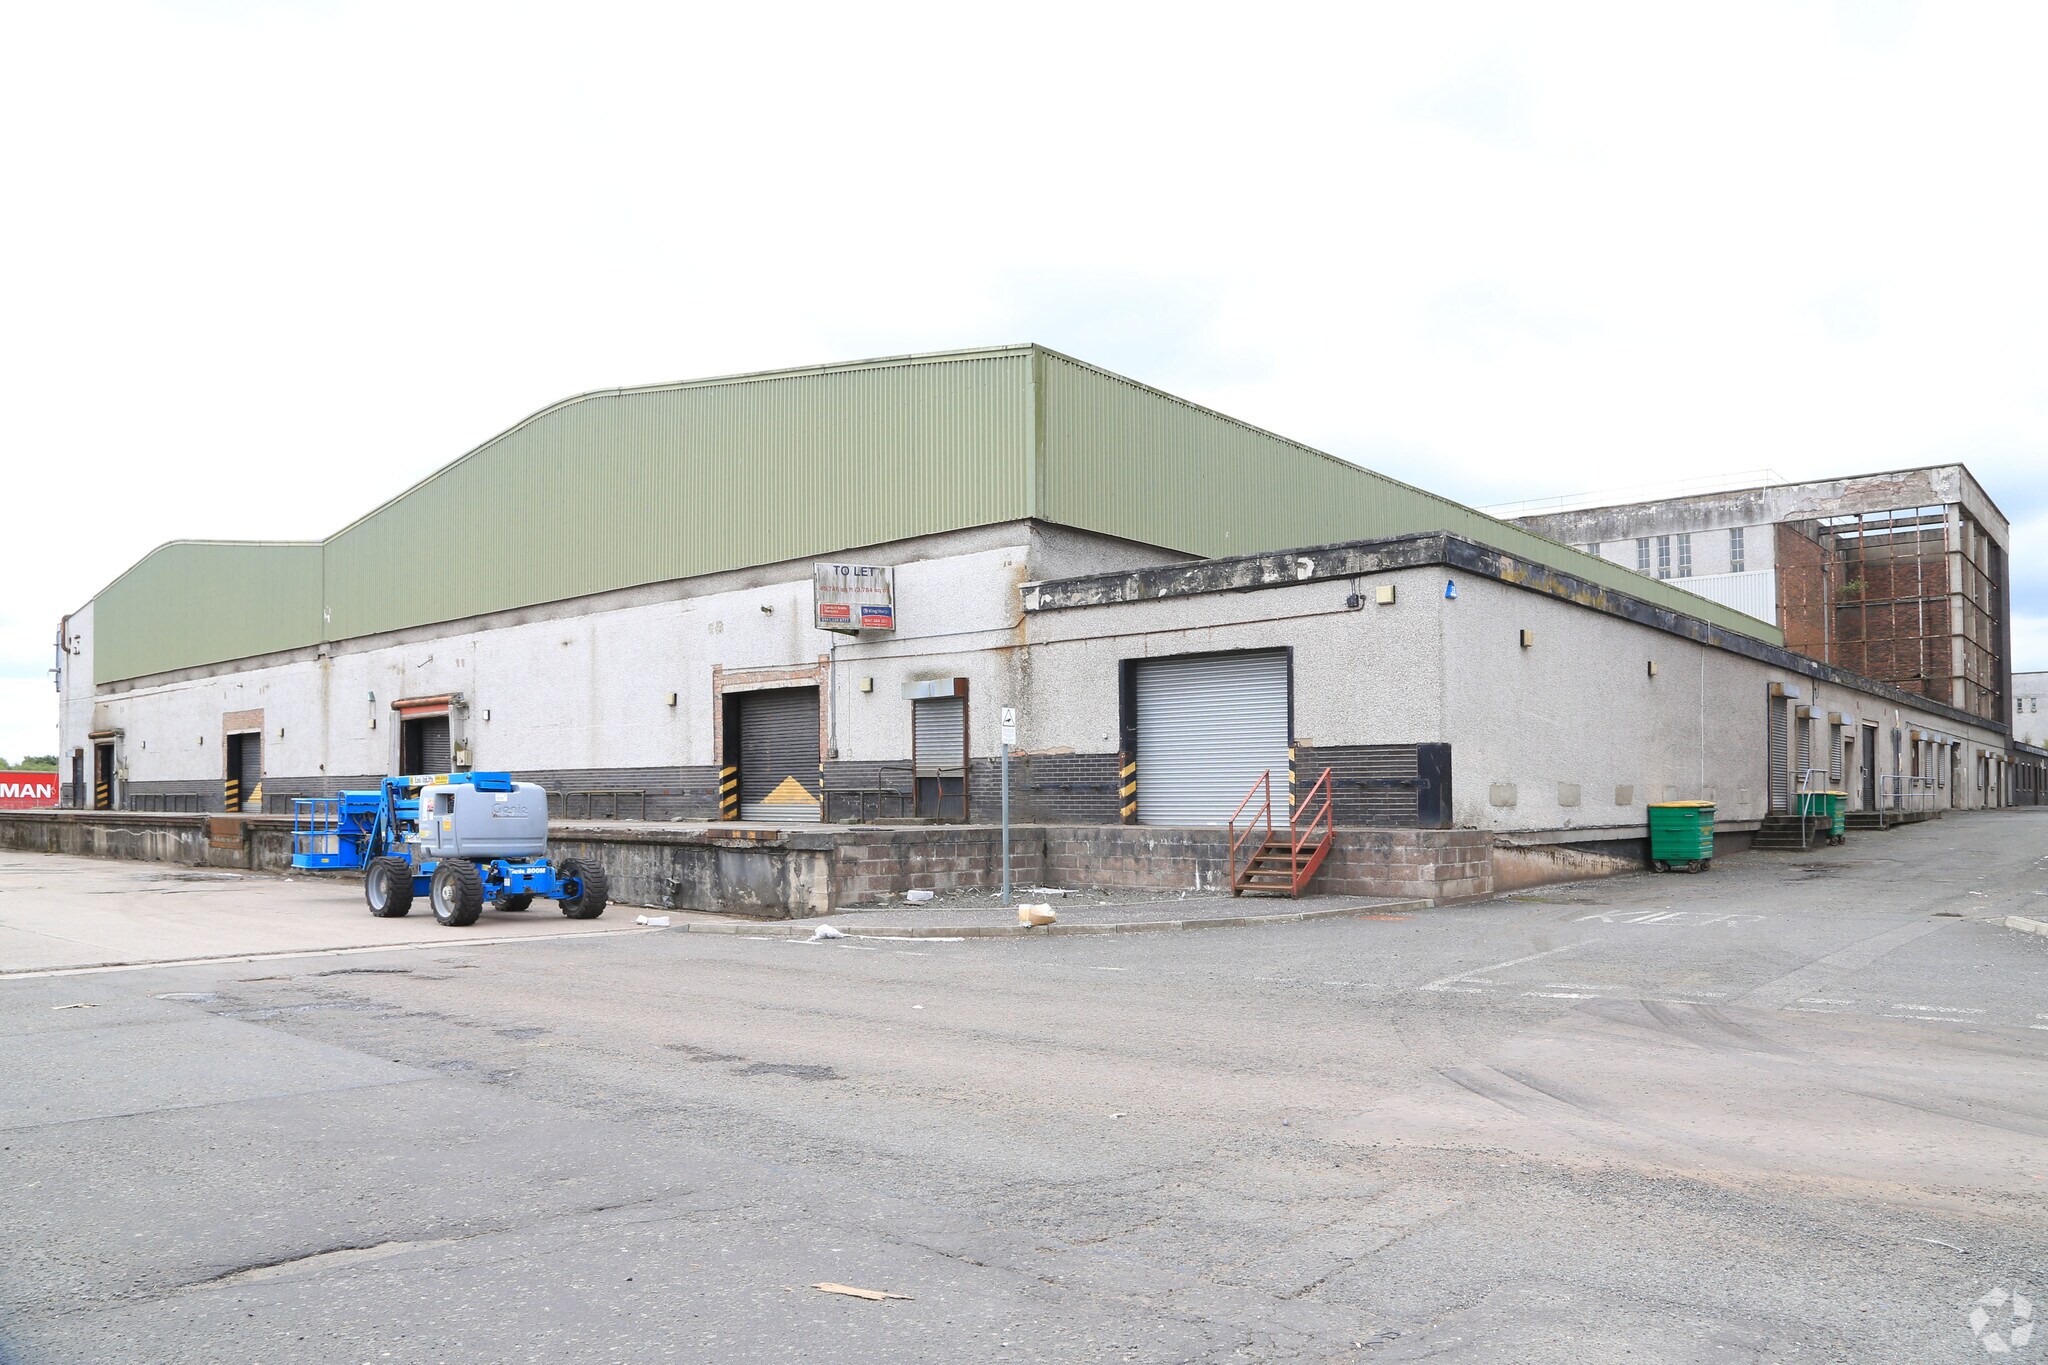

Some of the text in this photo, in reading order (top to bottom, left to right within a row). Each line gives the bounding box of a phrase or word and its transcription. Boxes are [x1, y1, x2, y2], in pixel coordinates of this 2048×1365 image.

[833, 565, 875, 577] TO LET
[0, 783, 51, 798] MAN
[492, 803, 528, 814] Genie
